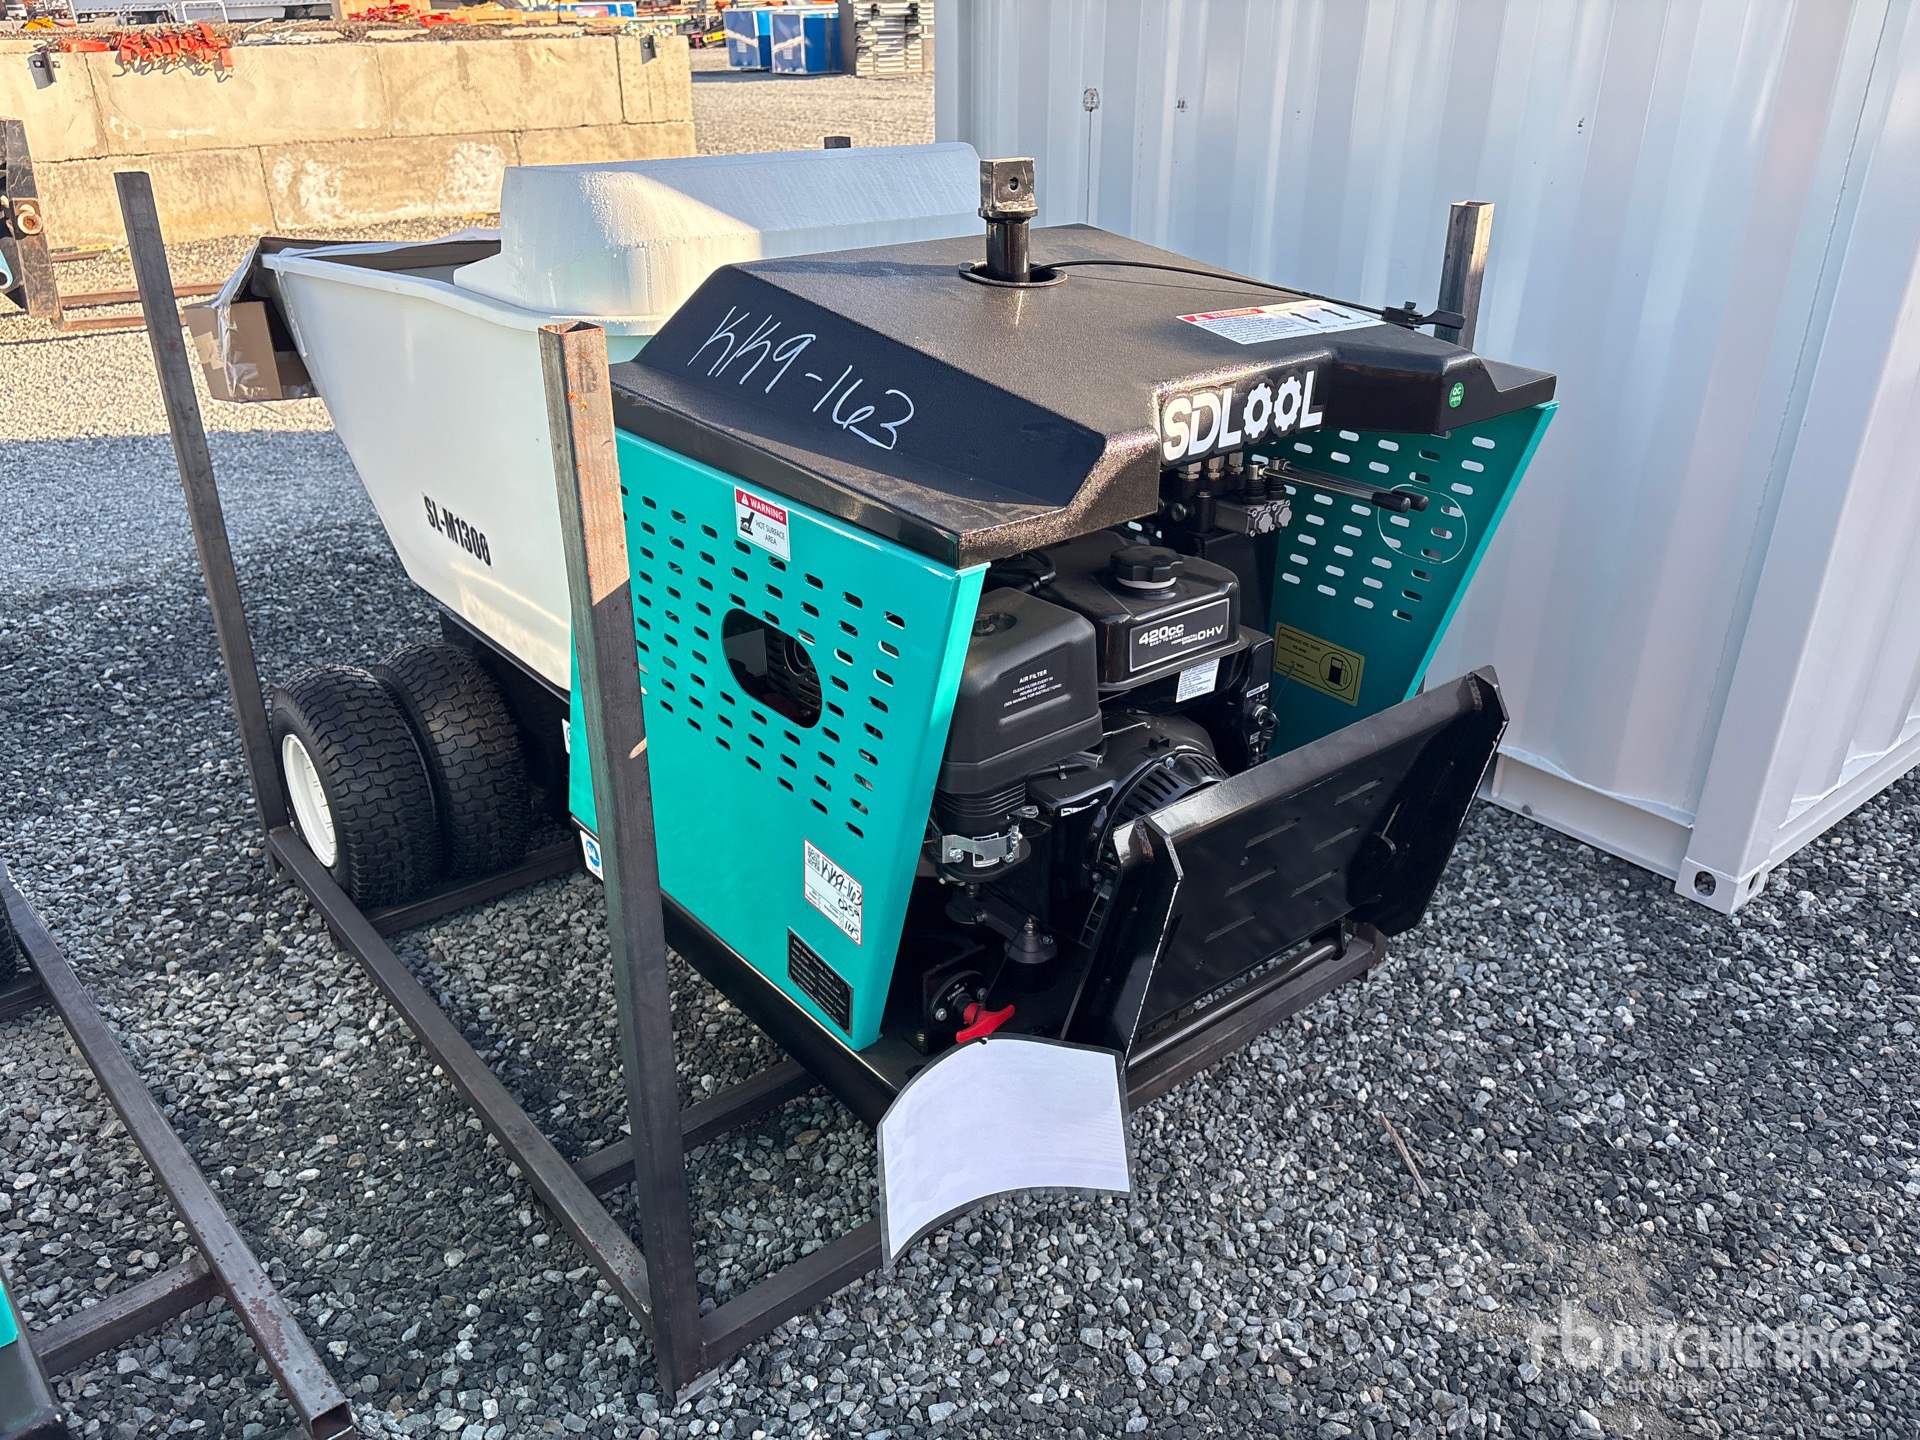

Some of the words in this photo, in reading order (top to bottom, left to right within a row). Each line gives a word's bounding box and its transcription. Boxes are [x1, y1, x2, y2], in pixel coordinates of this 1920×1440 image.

[687, 305, 915, 450] KK9-163
[1452, 386, 1462, 396] QC
[1162, 370, 1323, 461] SDLOOL
[750, 498, 784, 522] WARNING
[755, 520, 766, 531] HOT
[765, 524, 786, 541] SURFACE
[1138, 623, 1185, 645] 420cc
[1197, 624, 1224, 641] OHV
[1018, 675, 1029, 684] AIR
[1029, 669, 1048, 681] FILTER
